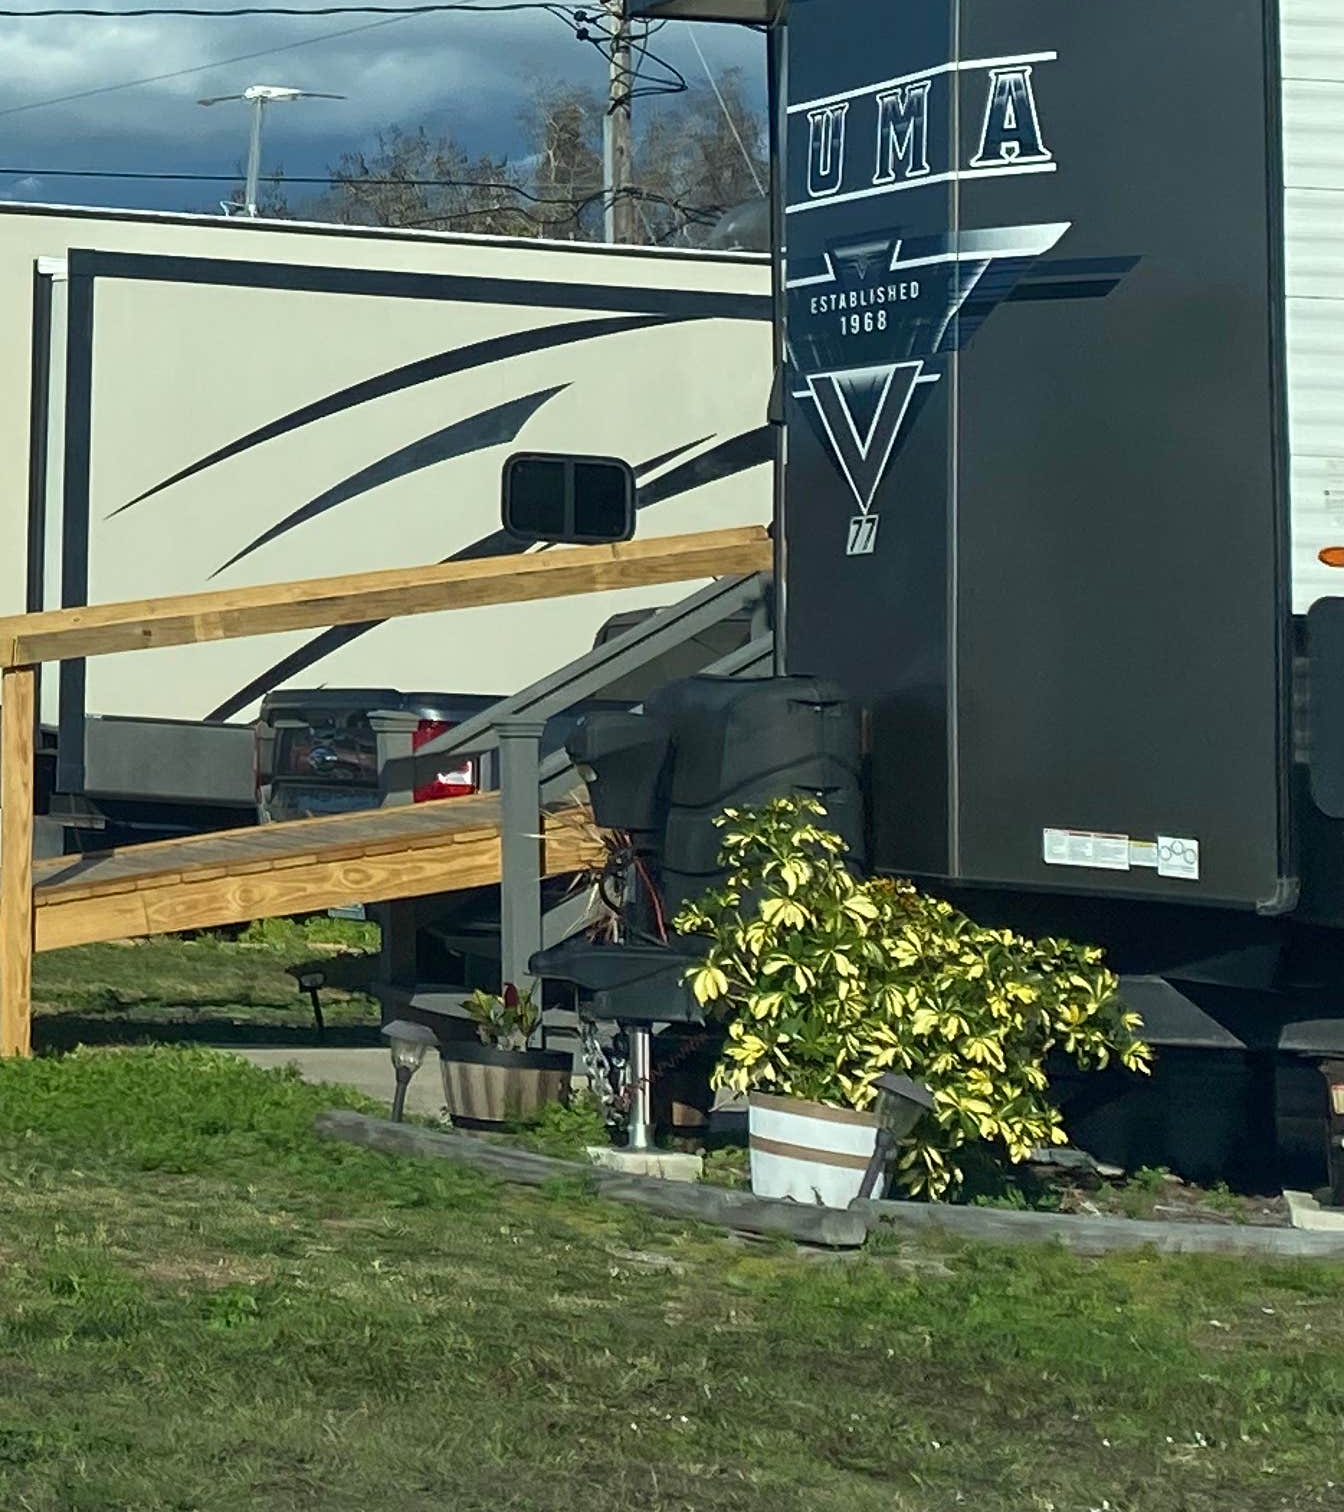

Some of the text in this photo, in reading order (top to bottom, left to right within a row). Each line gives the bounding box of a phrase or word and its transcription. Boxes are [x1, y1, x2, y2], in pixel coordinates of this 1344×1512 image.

[807, 65, 1053, 198] UMA
[810, 281, 920, 314] ESTABLISHED
[840, 310, 887, 336] 1968
